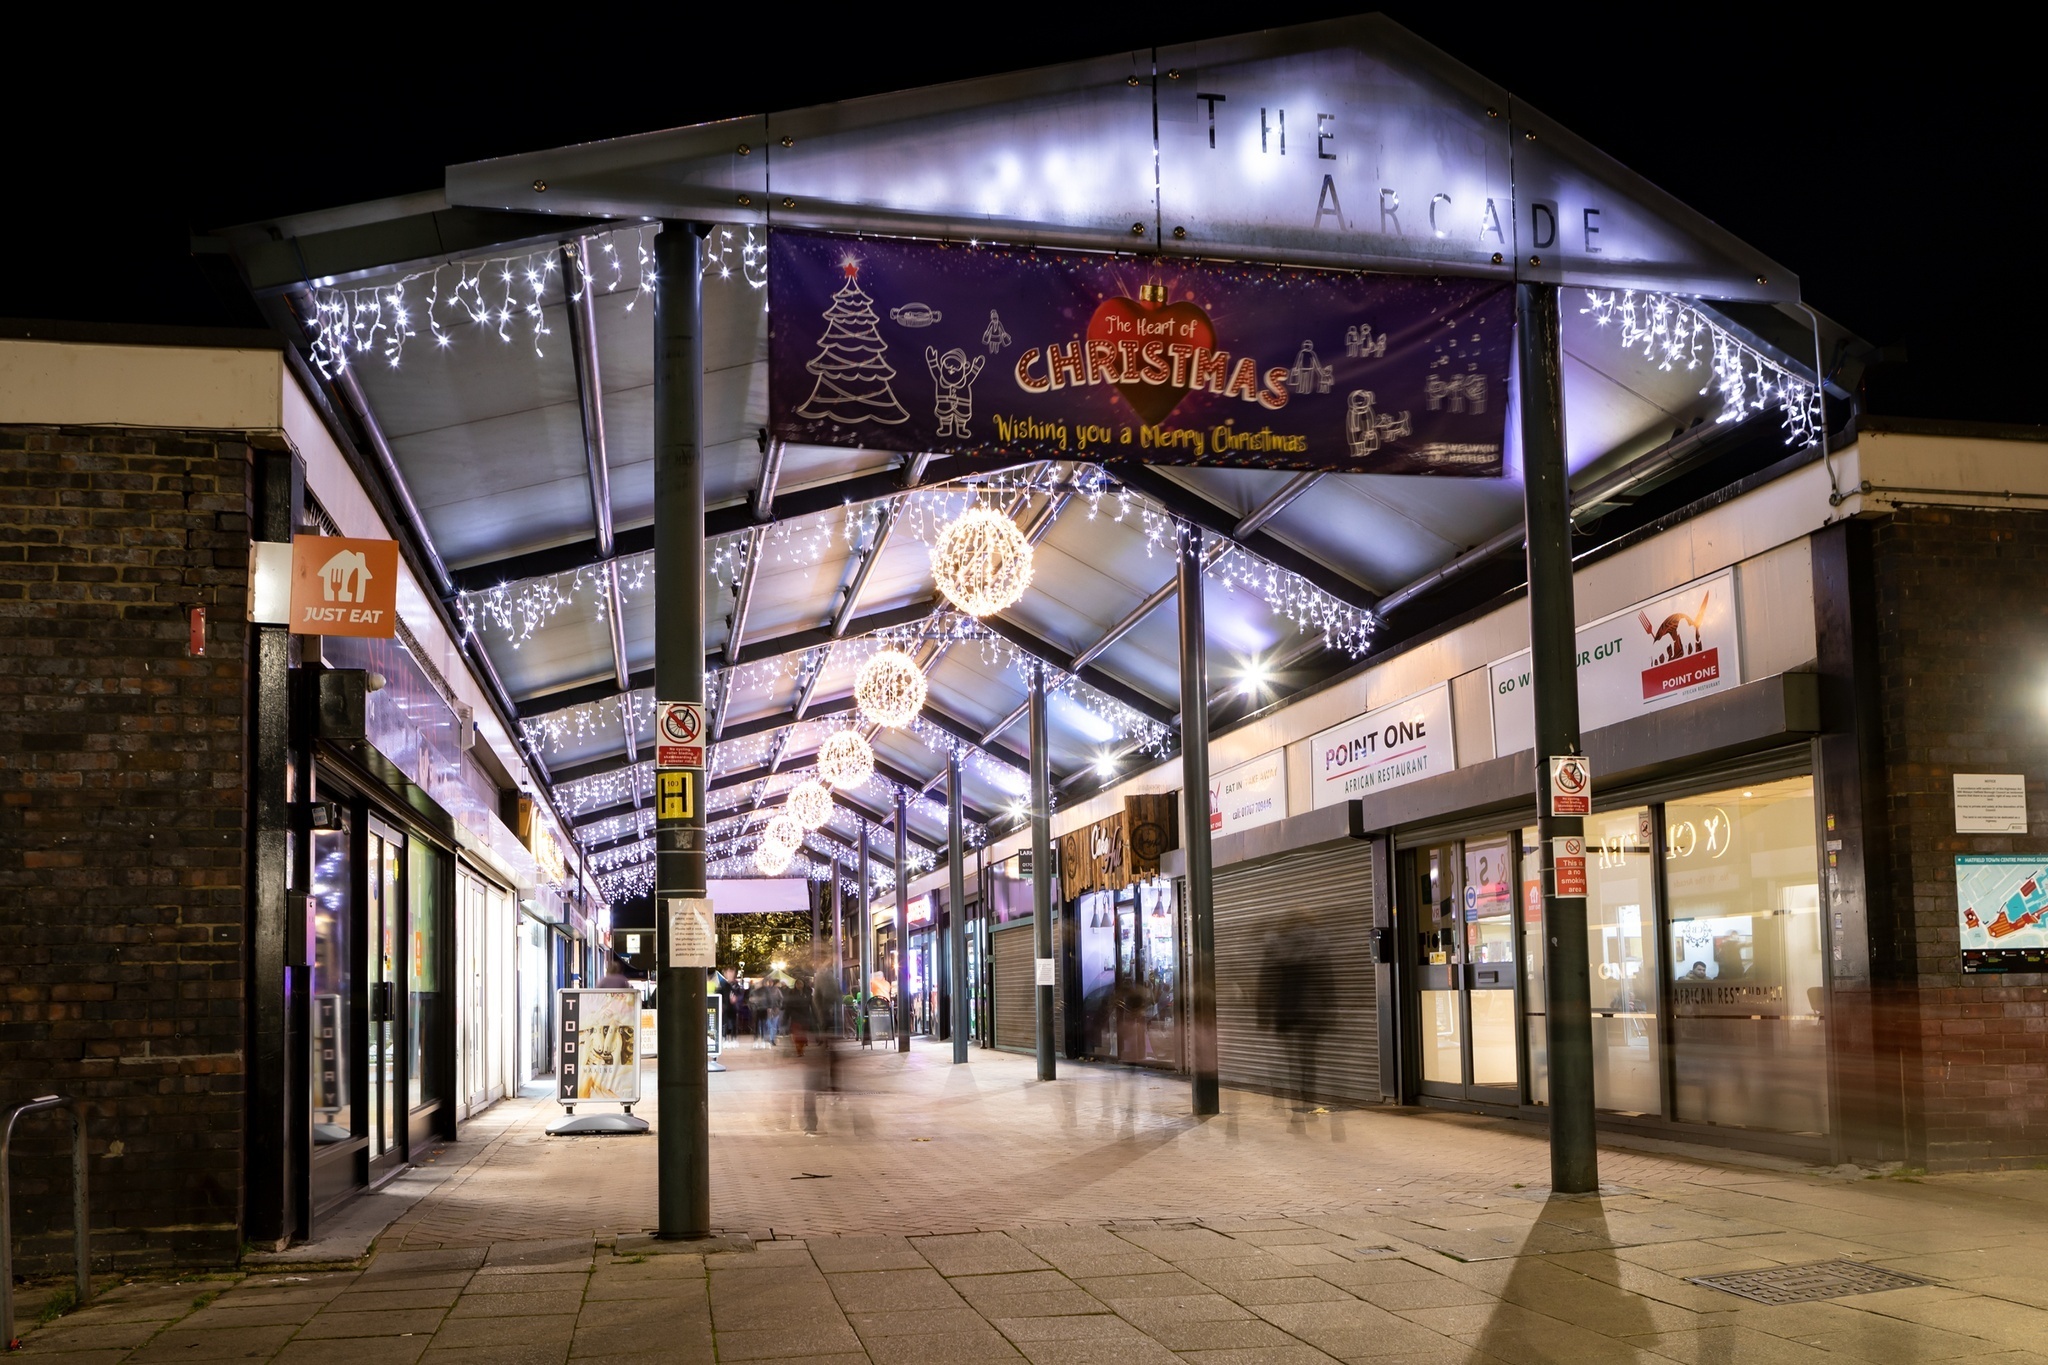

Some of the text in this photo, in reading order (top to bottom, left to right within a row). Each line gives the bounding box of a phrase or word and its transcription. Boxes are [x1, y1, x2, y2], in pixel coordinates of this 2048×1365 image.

[1197, 93, 1337, 160] THE
[1314, 174, 1602, 253] ARCADE
[1105, 315, 1198, 339] The Heart of
[1015, 340, 1289, 410] CHRISTMAS
[993, 414, 1307, 455] Wishing you a Merry Christmas
[303, 607, 384, 624] JUST EAT
[1498, 678, 1515, 695] GO
[1594, 638, 1623, 660] GUT
[1662, 665, 1717, 690] POINT ONE
[1326, 721, 1426, 771] POINT ONE
[1225, 782, 1236, 795] EAT
[1236, 780, 1243, 791] IN
[1345, 755, 1428, 794] AFRICAN RESTAURANT
[661, 777, 687, 814] H
[1561, 877, 1585, 885] smoking
[1563, 859, 1577, 867] This
[1674, 984, 1783, 1006] AFRICAN RESTAURANT
[564, 999, 577, 1096] TODAY
